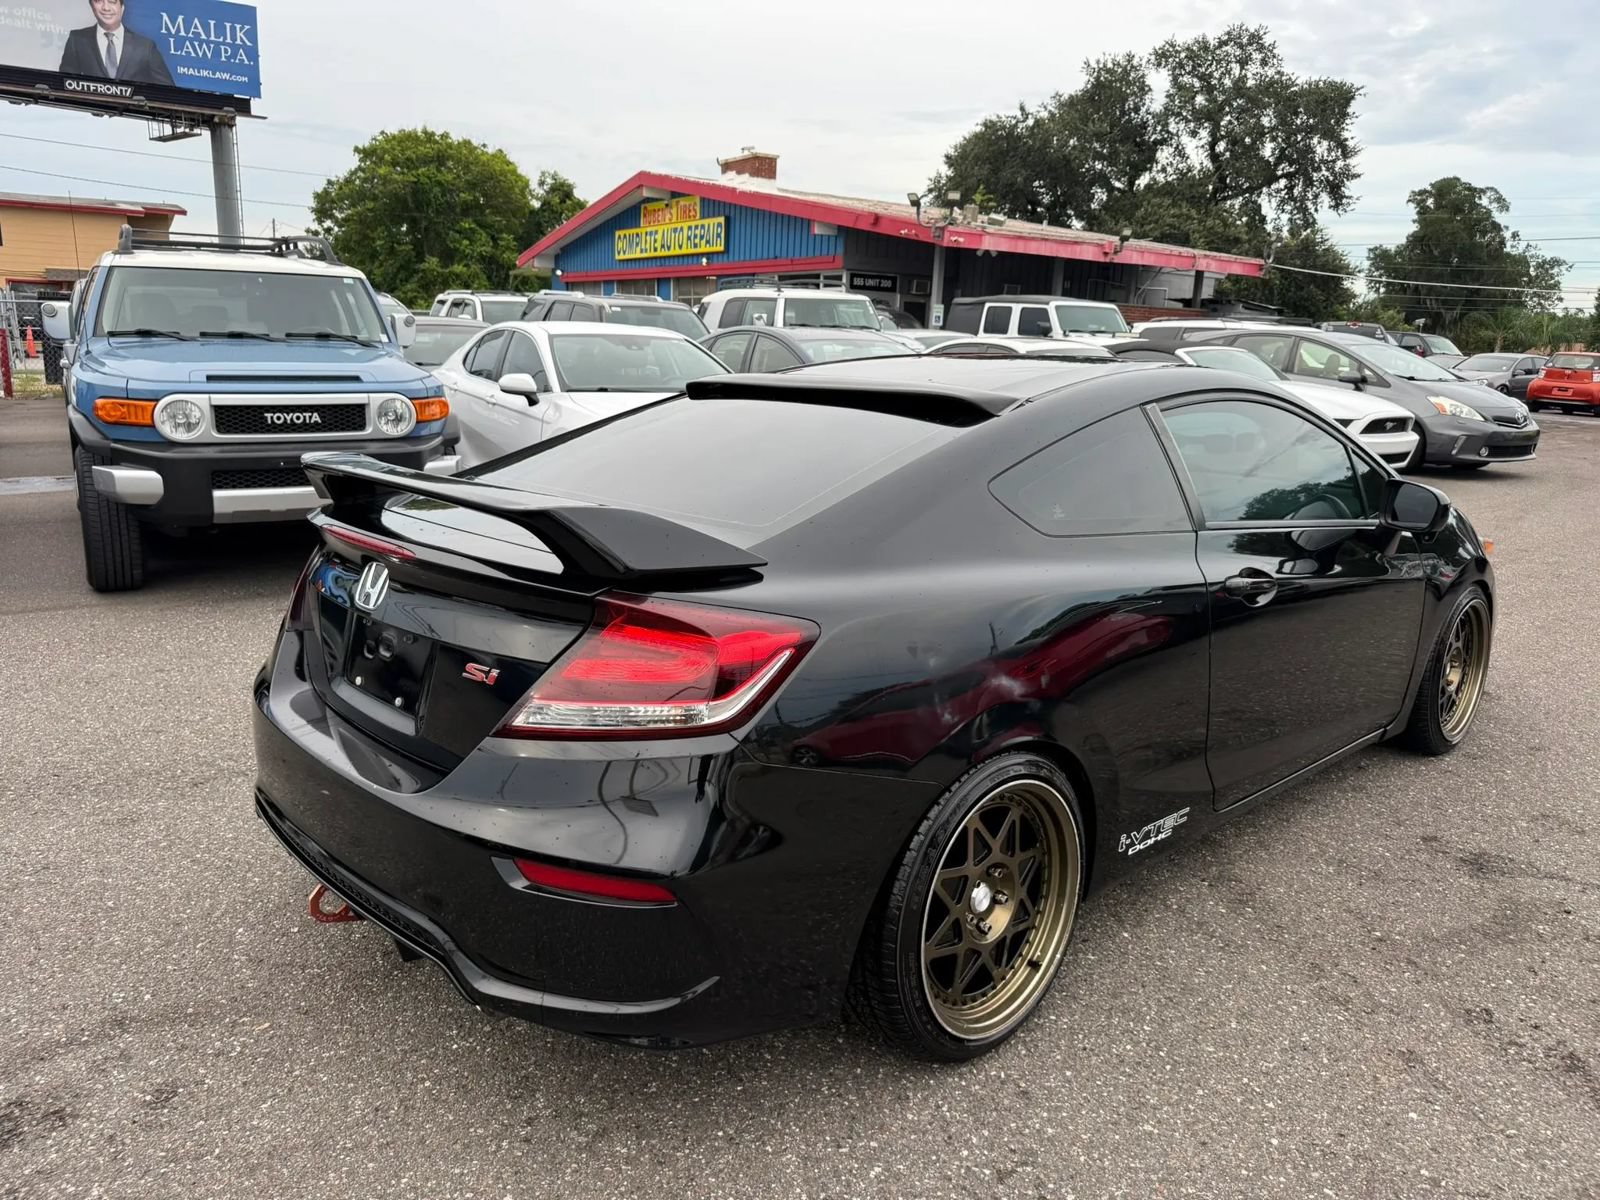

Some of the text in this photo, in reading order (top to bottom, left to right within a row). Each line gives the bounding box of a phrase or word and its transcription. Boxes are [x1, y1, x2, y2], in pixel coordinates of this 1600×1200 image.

[160, 12, 253, 46] MALIK
[168, 38, 253, 65] LAW P.A.
[675, 200, 698, 220] TIRES
[616, 222, 723, 256] COMPLETE AUTO REPAIR
[865, 278, 880, 288] UNIT
[264, 412, 322, 425] TOYOTA
[462, 662, 501, 686] Si
[1128, 828, 1173, 856] DOHC
